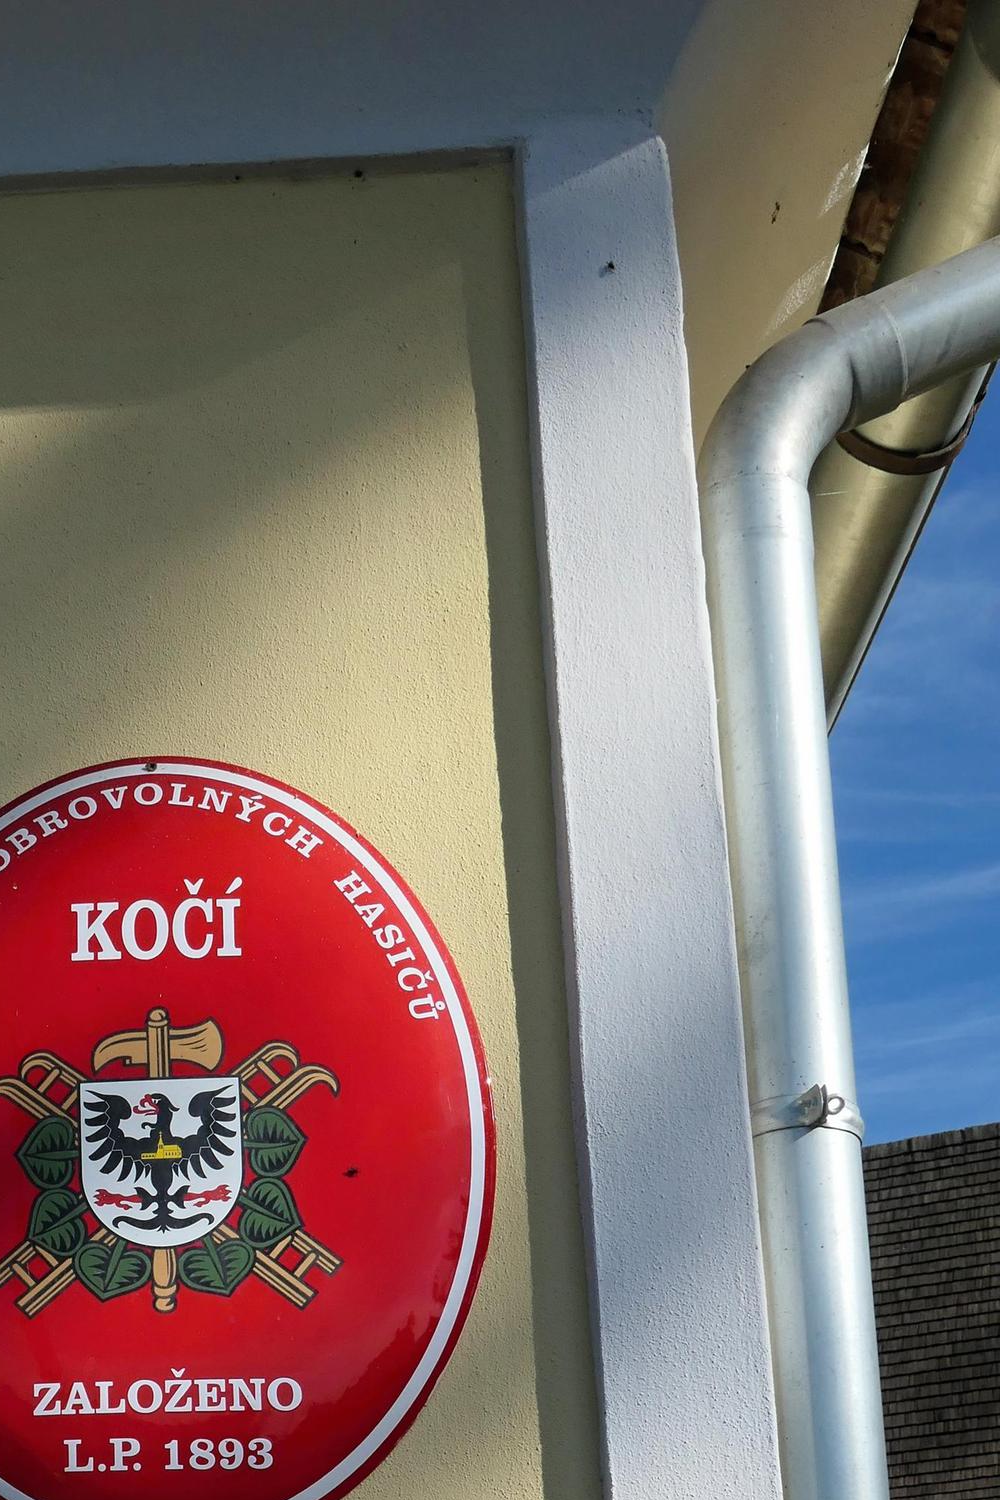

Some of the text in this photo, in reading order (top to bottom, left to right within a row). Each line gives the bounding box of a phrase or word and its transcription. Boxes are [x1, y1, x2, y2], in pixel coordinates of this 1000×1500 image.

[70, 876, 243, 961] KOČÍ
[333, 870, 446, 1020] HASIČŮ
[33, 1367, 303, 1416] ZALOŽENO
[63, 1437, 274, 1473] L.P. 1893
